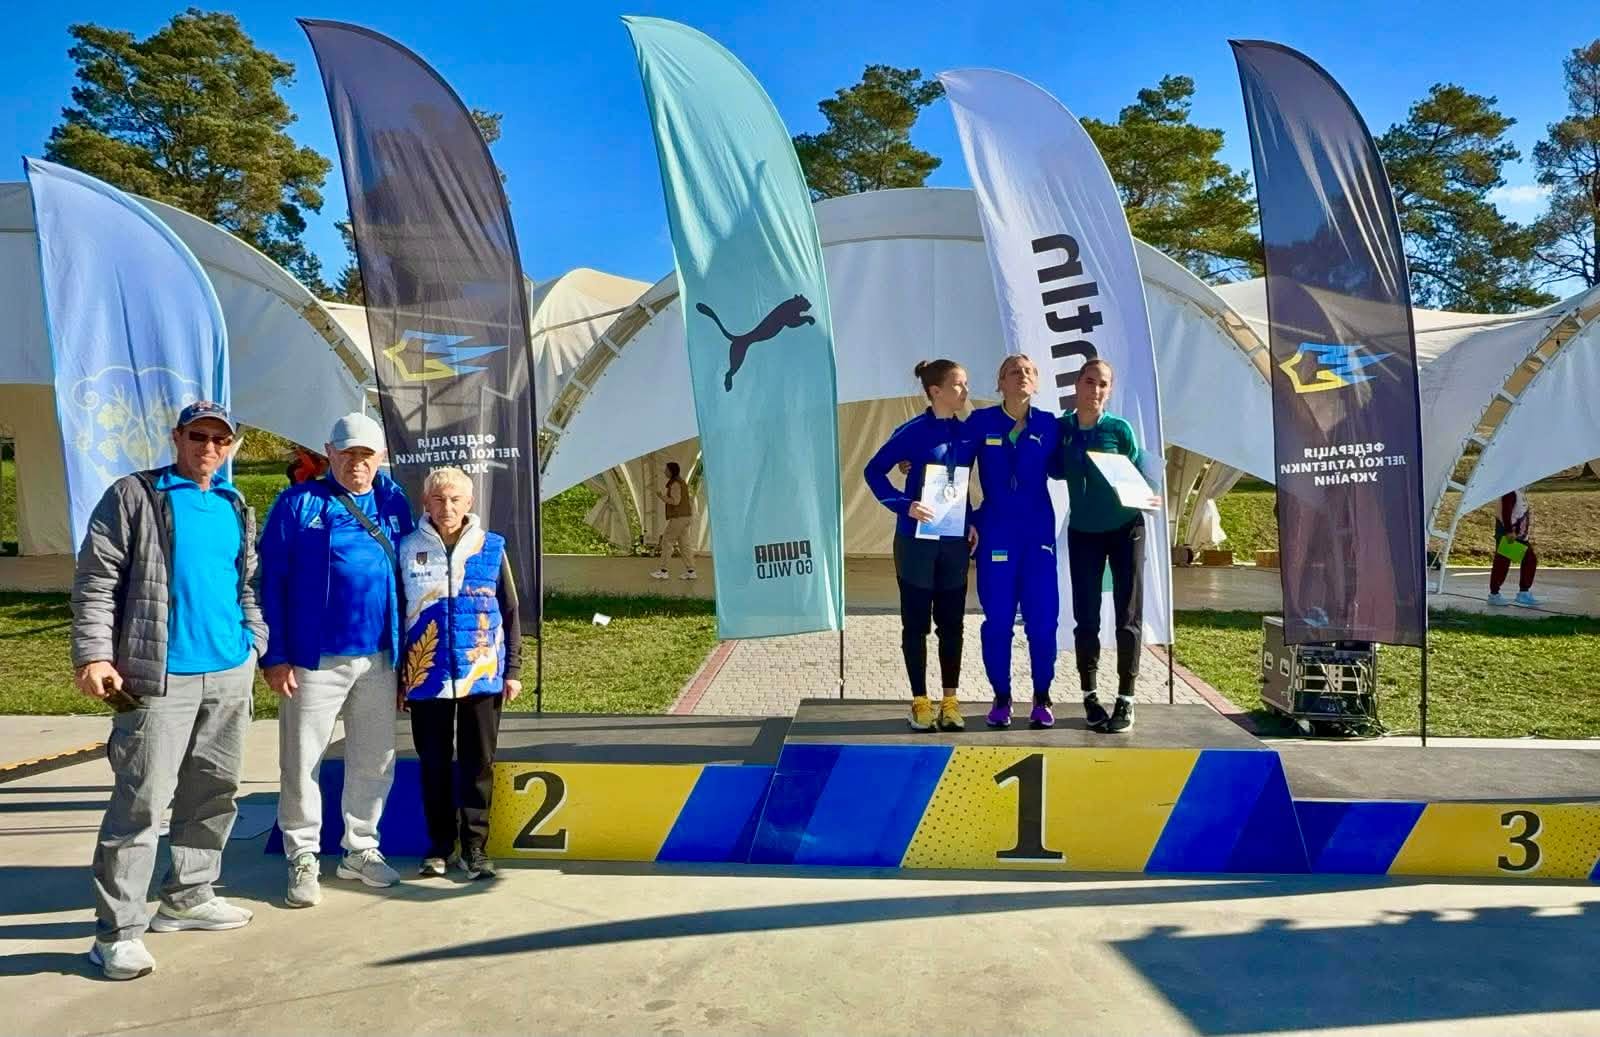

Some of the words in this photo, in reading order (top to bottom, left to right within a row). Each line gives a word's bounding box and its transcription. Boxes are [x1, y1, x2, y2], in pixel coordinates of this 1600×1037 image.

[512, 770, 569, 853] 2
[993, 753, 1066, 864] 1
[1497, 809, 1545, 875] 3
